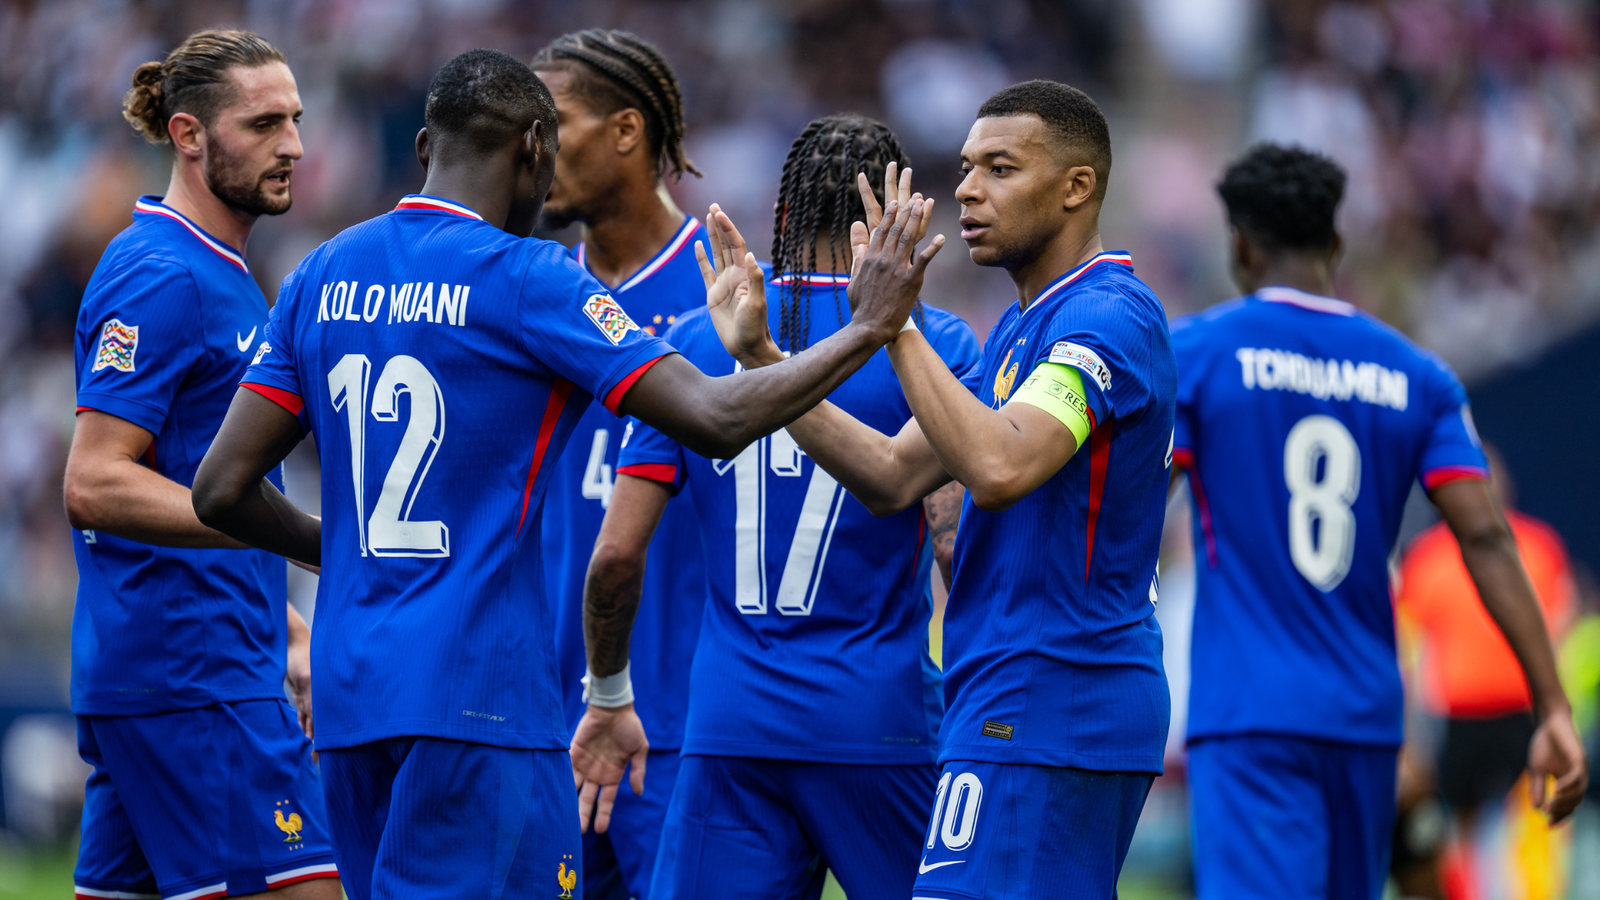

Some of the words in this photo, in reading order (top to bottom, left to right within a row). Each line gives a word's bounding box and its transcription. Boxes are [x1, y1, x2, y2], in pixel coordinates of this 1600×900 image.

[317, 280, 385, 323] KOLO
[388, 282, 470, 327] MUANI
[1053, 348, 1097, 369] FOUNDATION
[327, 354, 450, 558] 12
[581, 428, 614, 510] 4
[712, 350, 847, 616] 17
[1283, 413, 1362, 593] 8
[927, 771, 983, 851] 10
